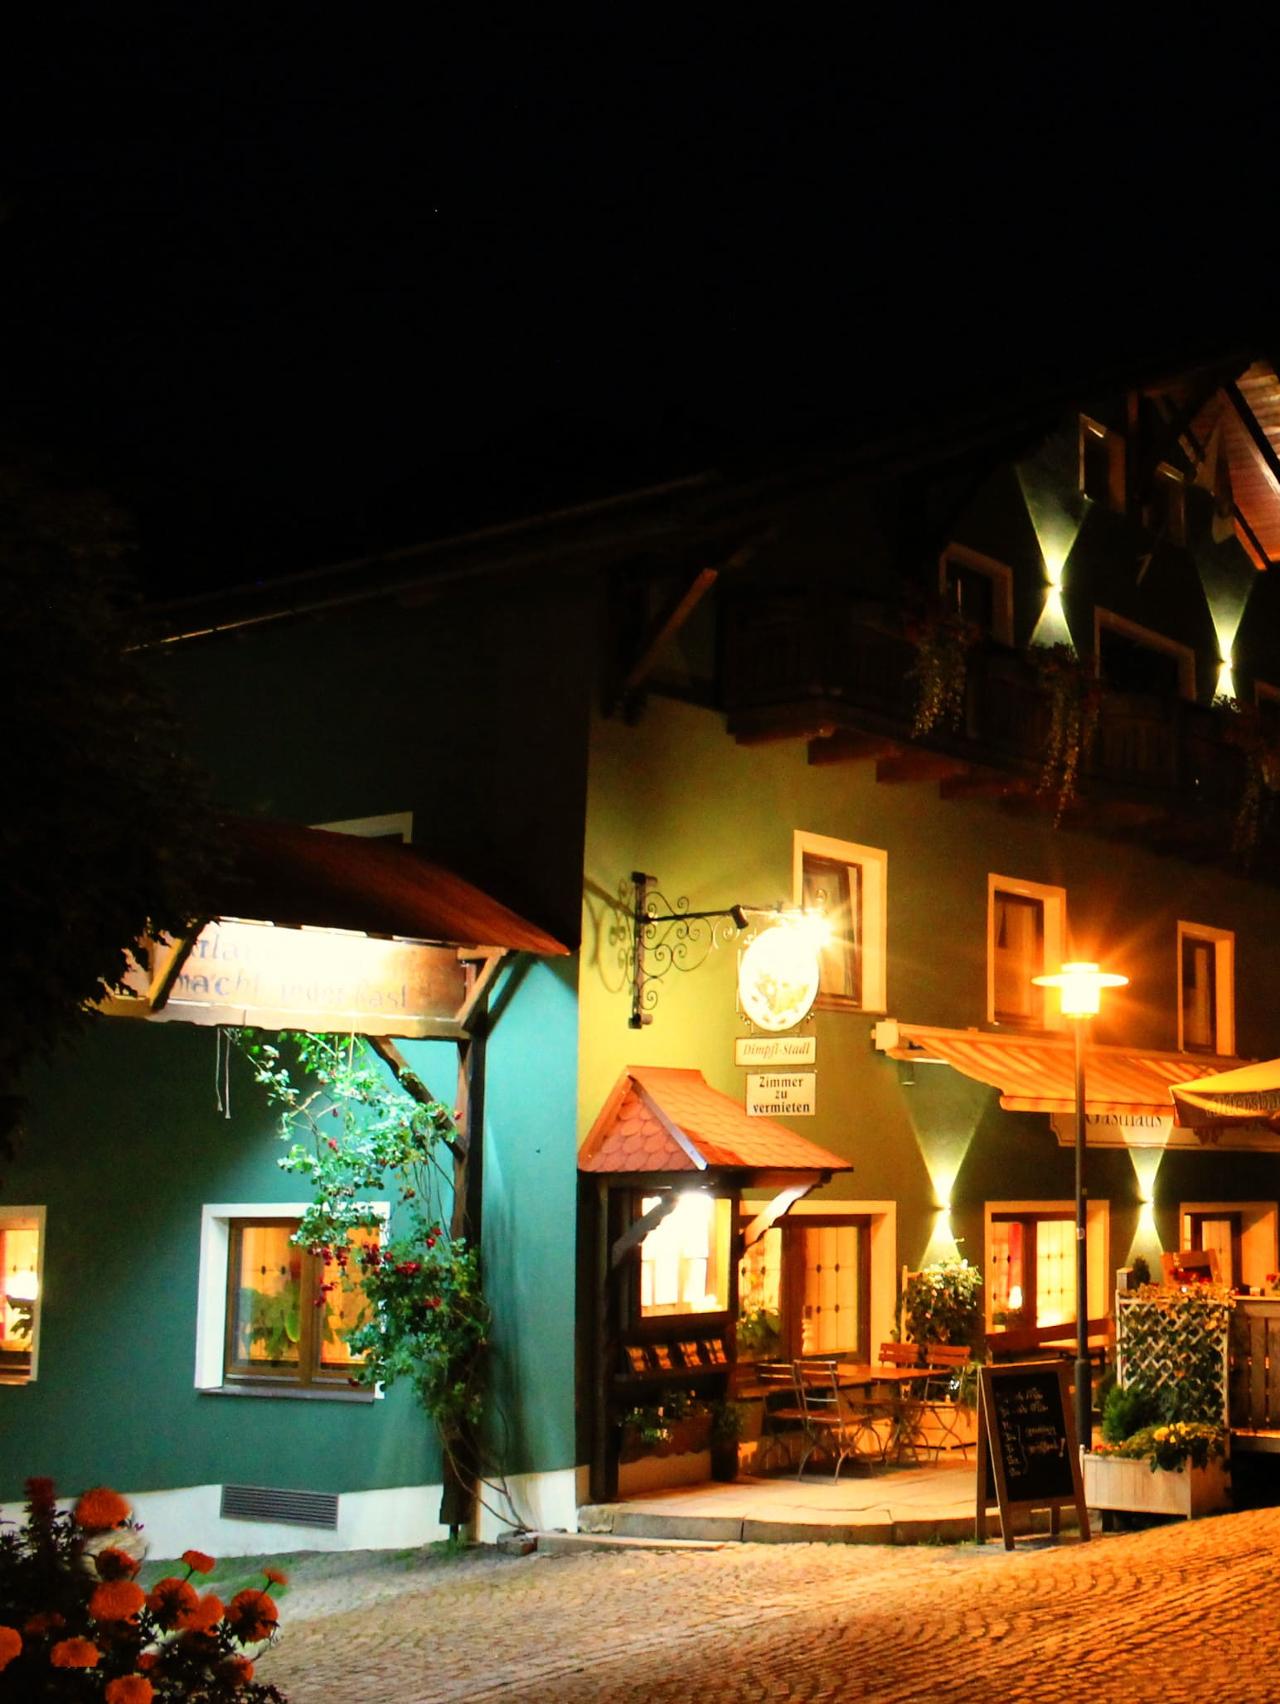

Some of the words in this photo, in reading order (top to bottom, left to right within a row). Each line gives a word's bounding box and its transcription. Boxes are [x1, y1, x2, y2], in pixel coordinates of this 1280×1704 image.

[759, 1076, 804, 1088] Zimmer
[775, 1090, 788, 1099] zu
[753, 1102, 810, 1113] vermieten
